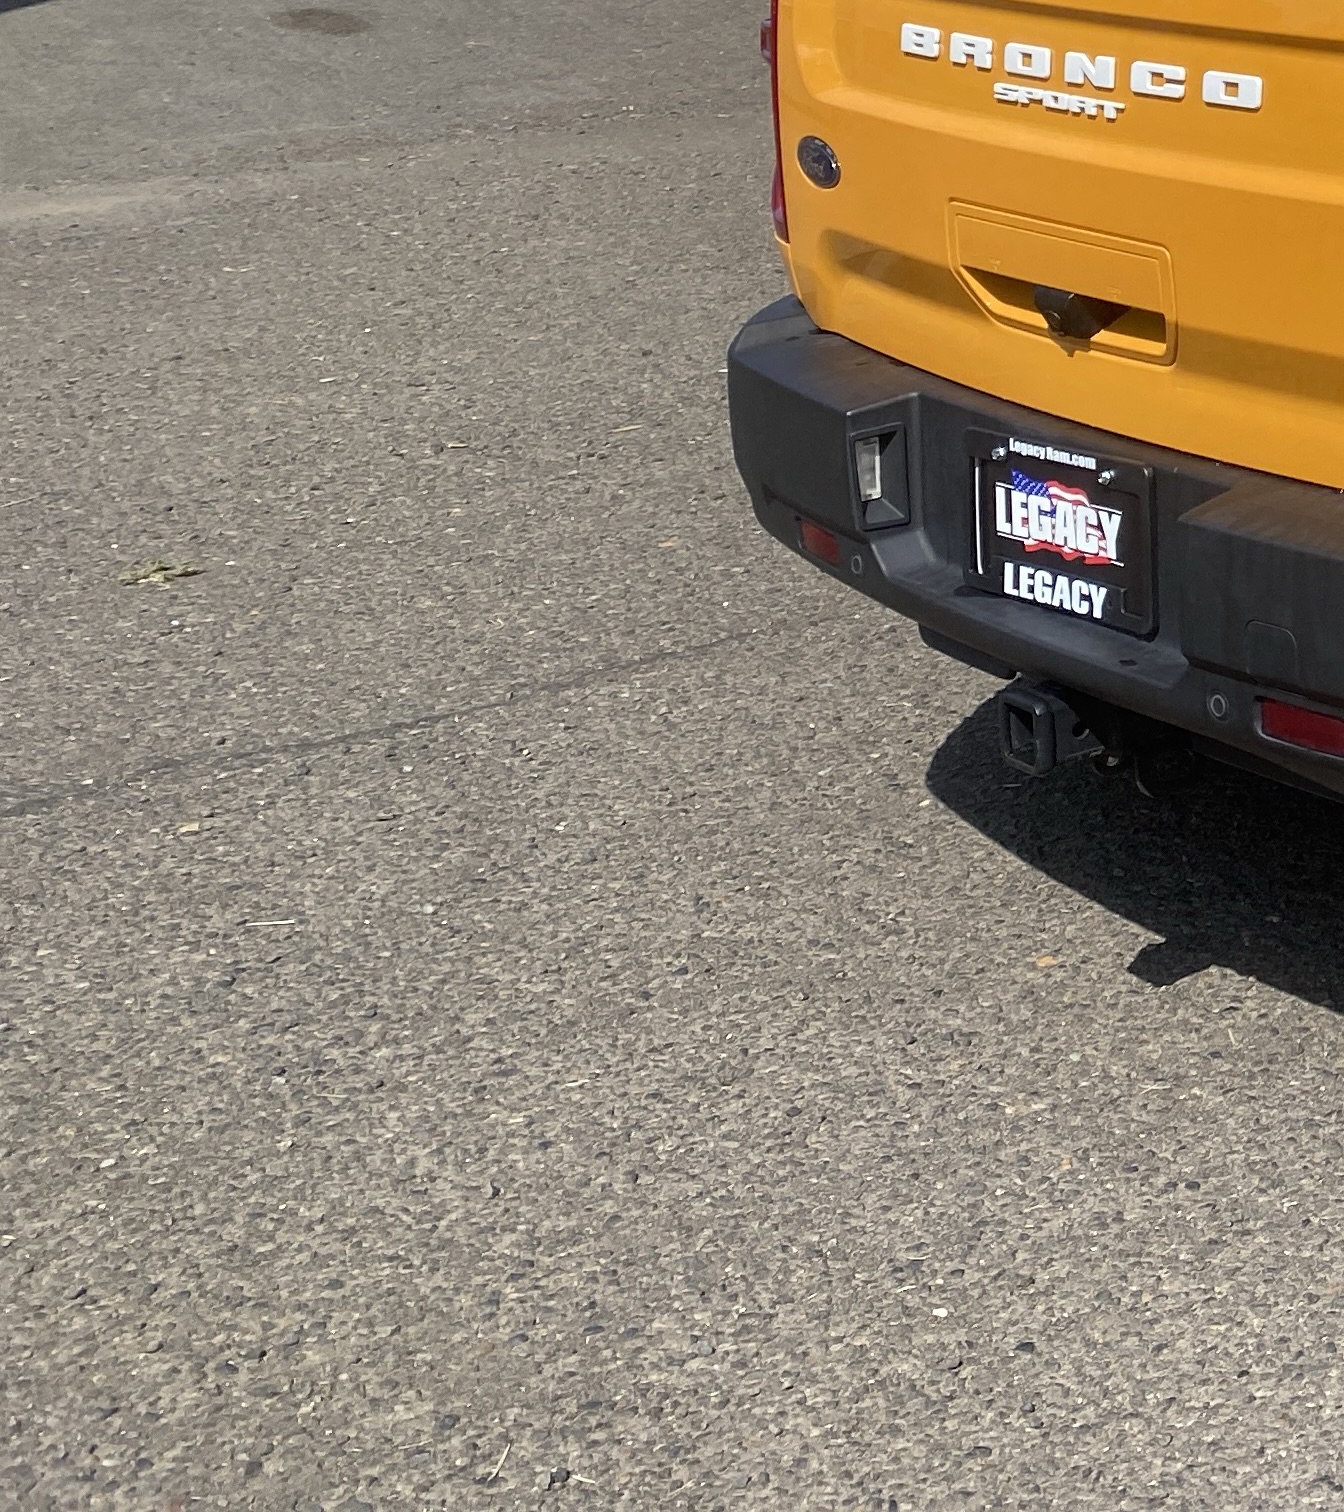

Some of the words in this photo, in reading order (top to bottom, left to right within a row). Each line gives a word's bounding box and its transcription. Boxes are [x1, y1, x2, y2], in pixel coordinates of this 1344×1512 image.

[900, 22, 1263, 110] BRONCO
[993, 82, 1126, 120] SPORT
[995, 486, 1122, 560] LEGACY
[1003, 561, 1108, 619] LEGACY
